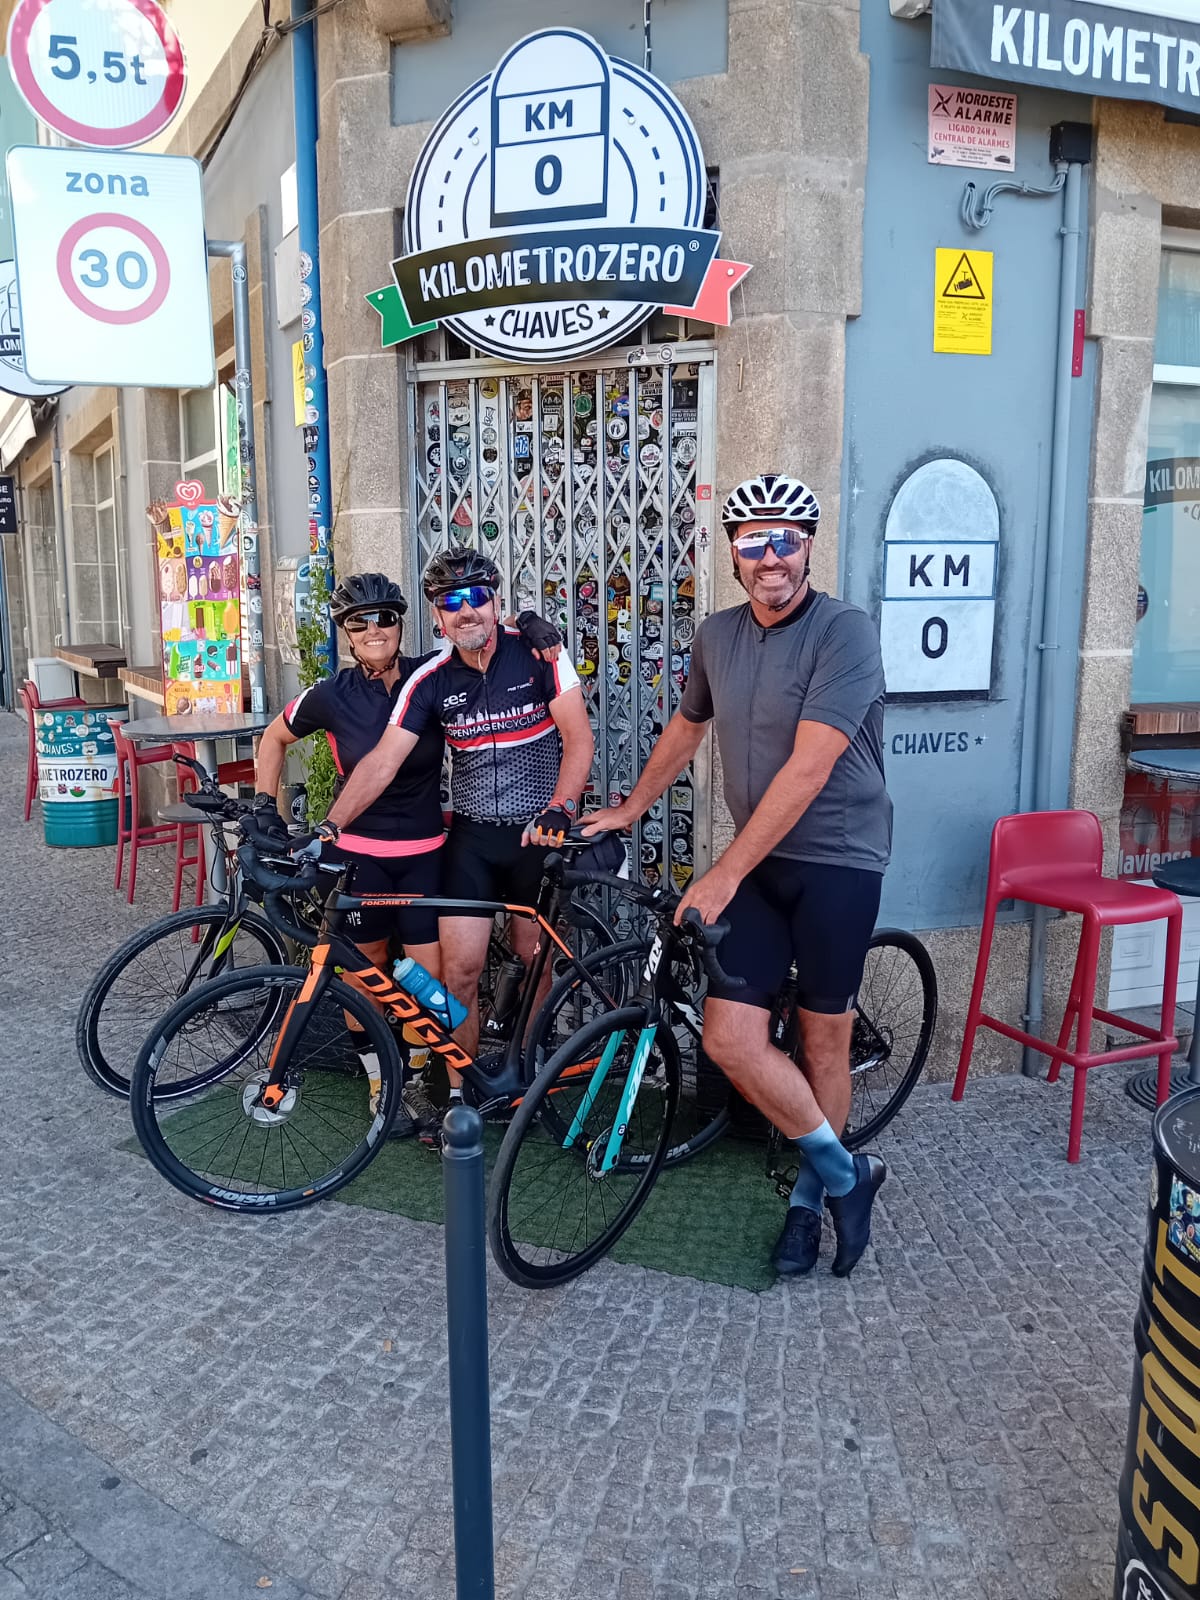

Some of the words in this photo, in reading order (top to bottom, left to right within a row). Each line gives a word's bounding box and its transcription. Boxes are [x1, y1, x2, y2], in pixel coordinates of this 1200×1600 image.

[48, 34, 147, 85] 5,5t
[990, 4, 1200, 97] KILOMETR
[956, 91, 1015, 110] NORDESTE
[525, 99, 574, 132] KM
[954, 106, 1013, 126] ALARME
[934, 132, 965, 144] CENTRAL
[967, 136, 977, 145] DE
[978, 137, 1010, 149] ALARMES
[948, 123, 975, 134] LIGADO
[992, 128, 997, 137] A
[65, 171, 150, 197] zona
[78, 248, 149, 290] 30
[499, 303, 594, 338] CHAVES
[891, 731, 969, 756] CHAVES
